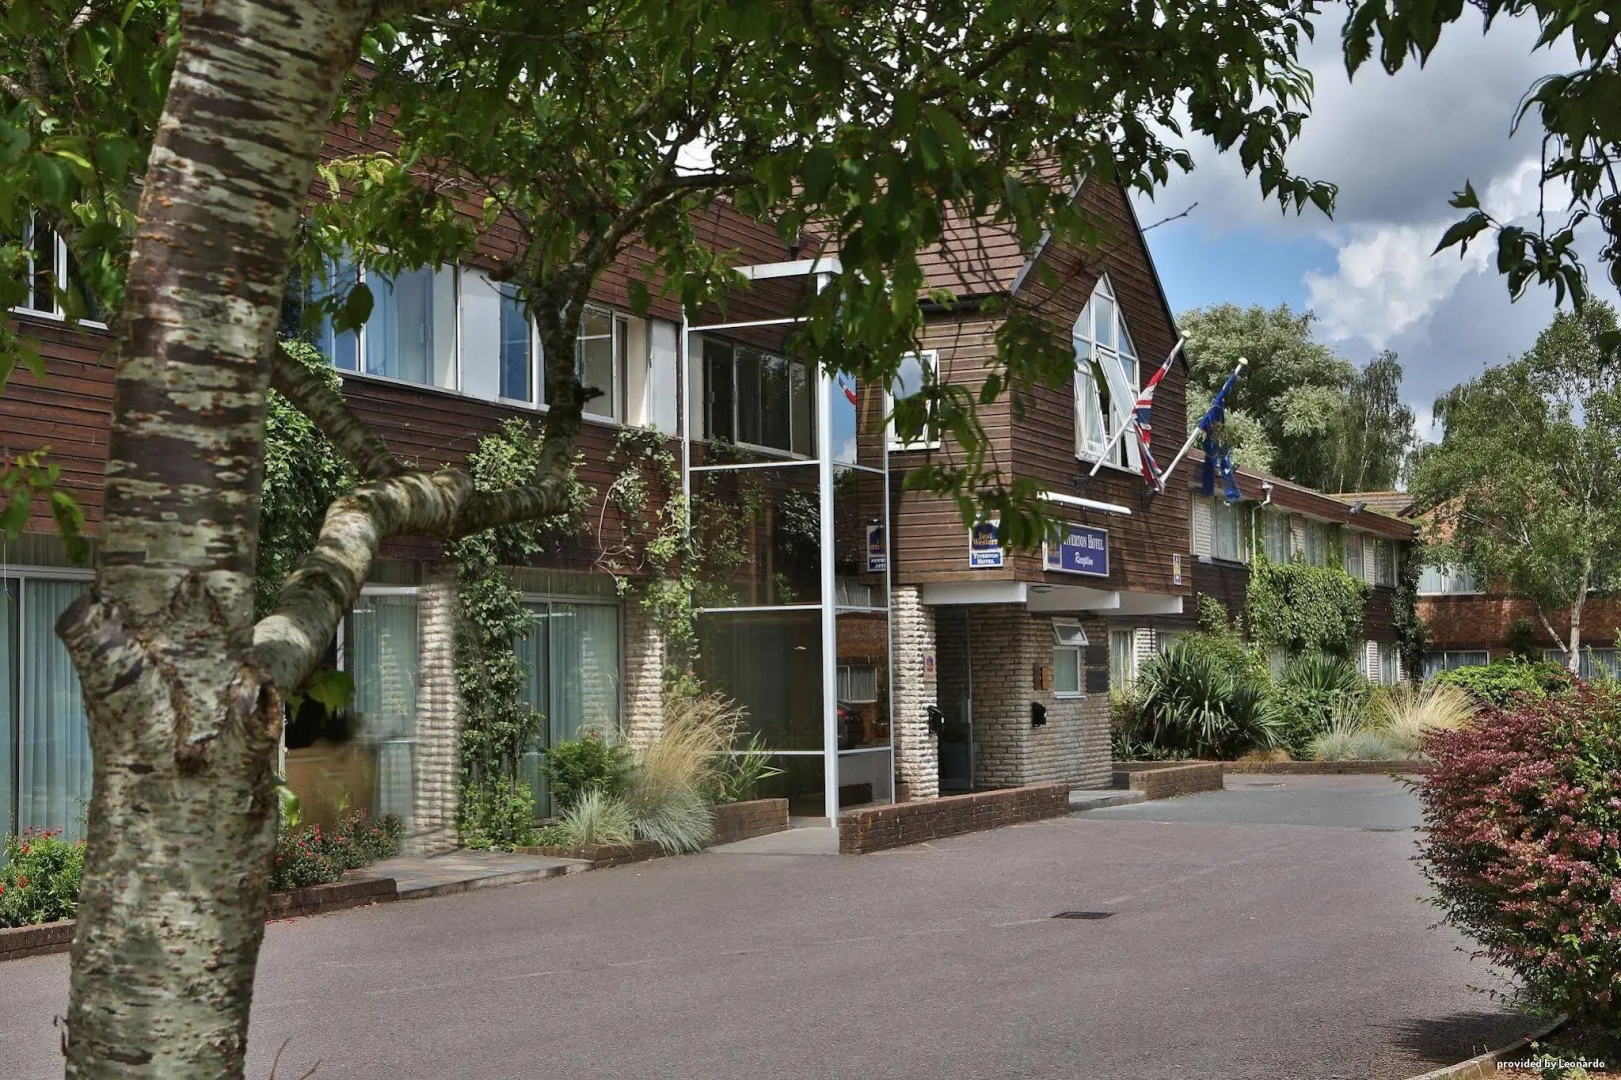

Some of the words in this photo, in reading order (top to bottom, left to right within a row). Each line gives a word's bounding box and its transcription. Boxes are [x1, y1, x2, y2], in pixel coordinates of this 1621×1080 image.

[978, 531, 993, 539] Best
[972, 538, 999, 546] Western
[1087, 534, 1104, 551] HOTEL
[1074, 551, 1094, 568] Reception
